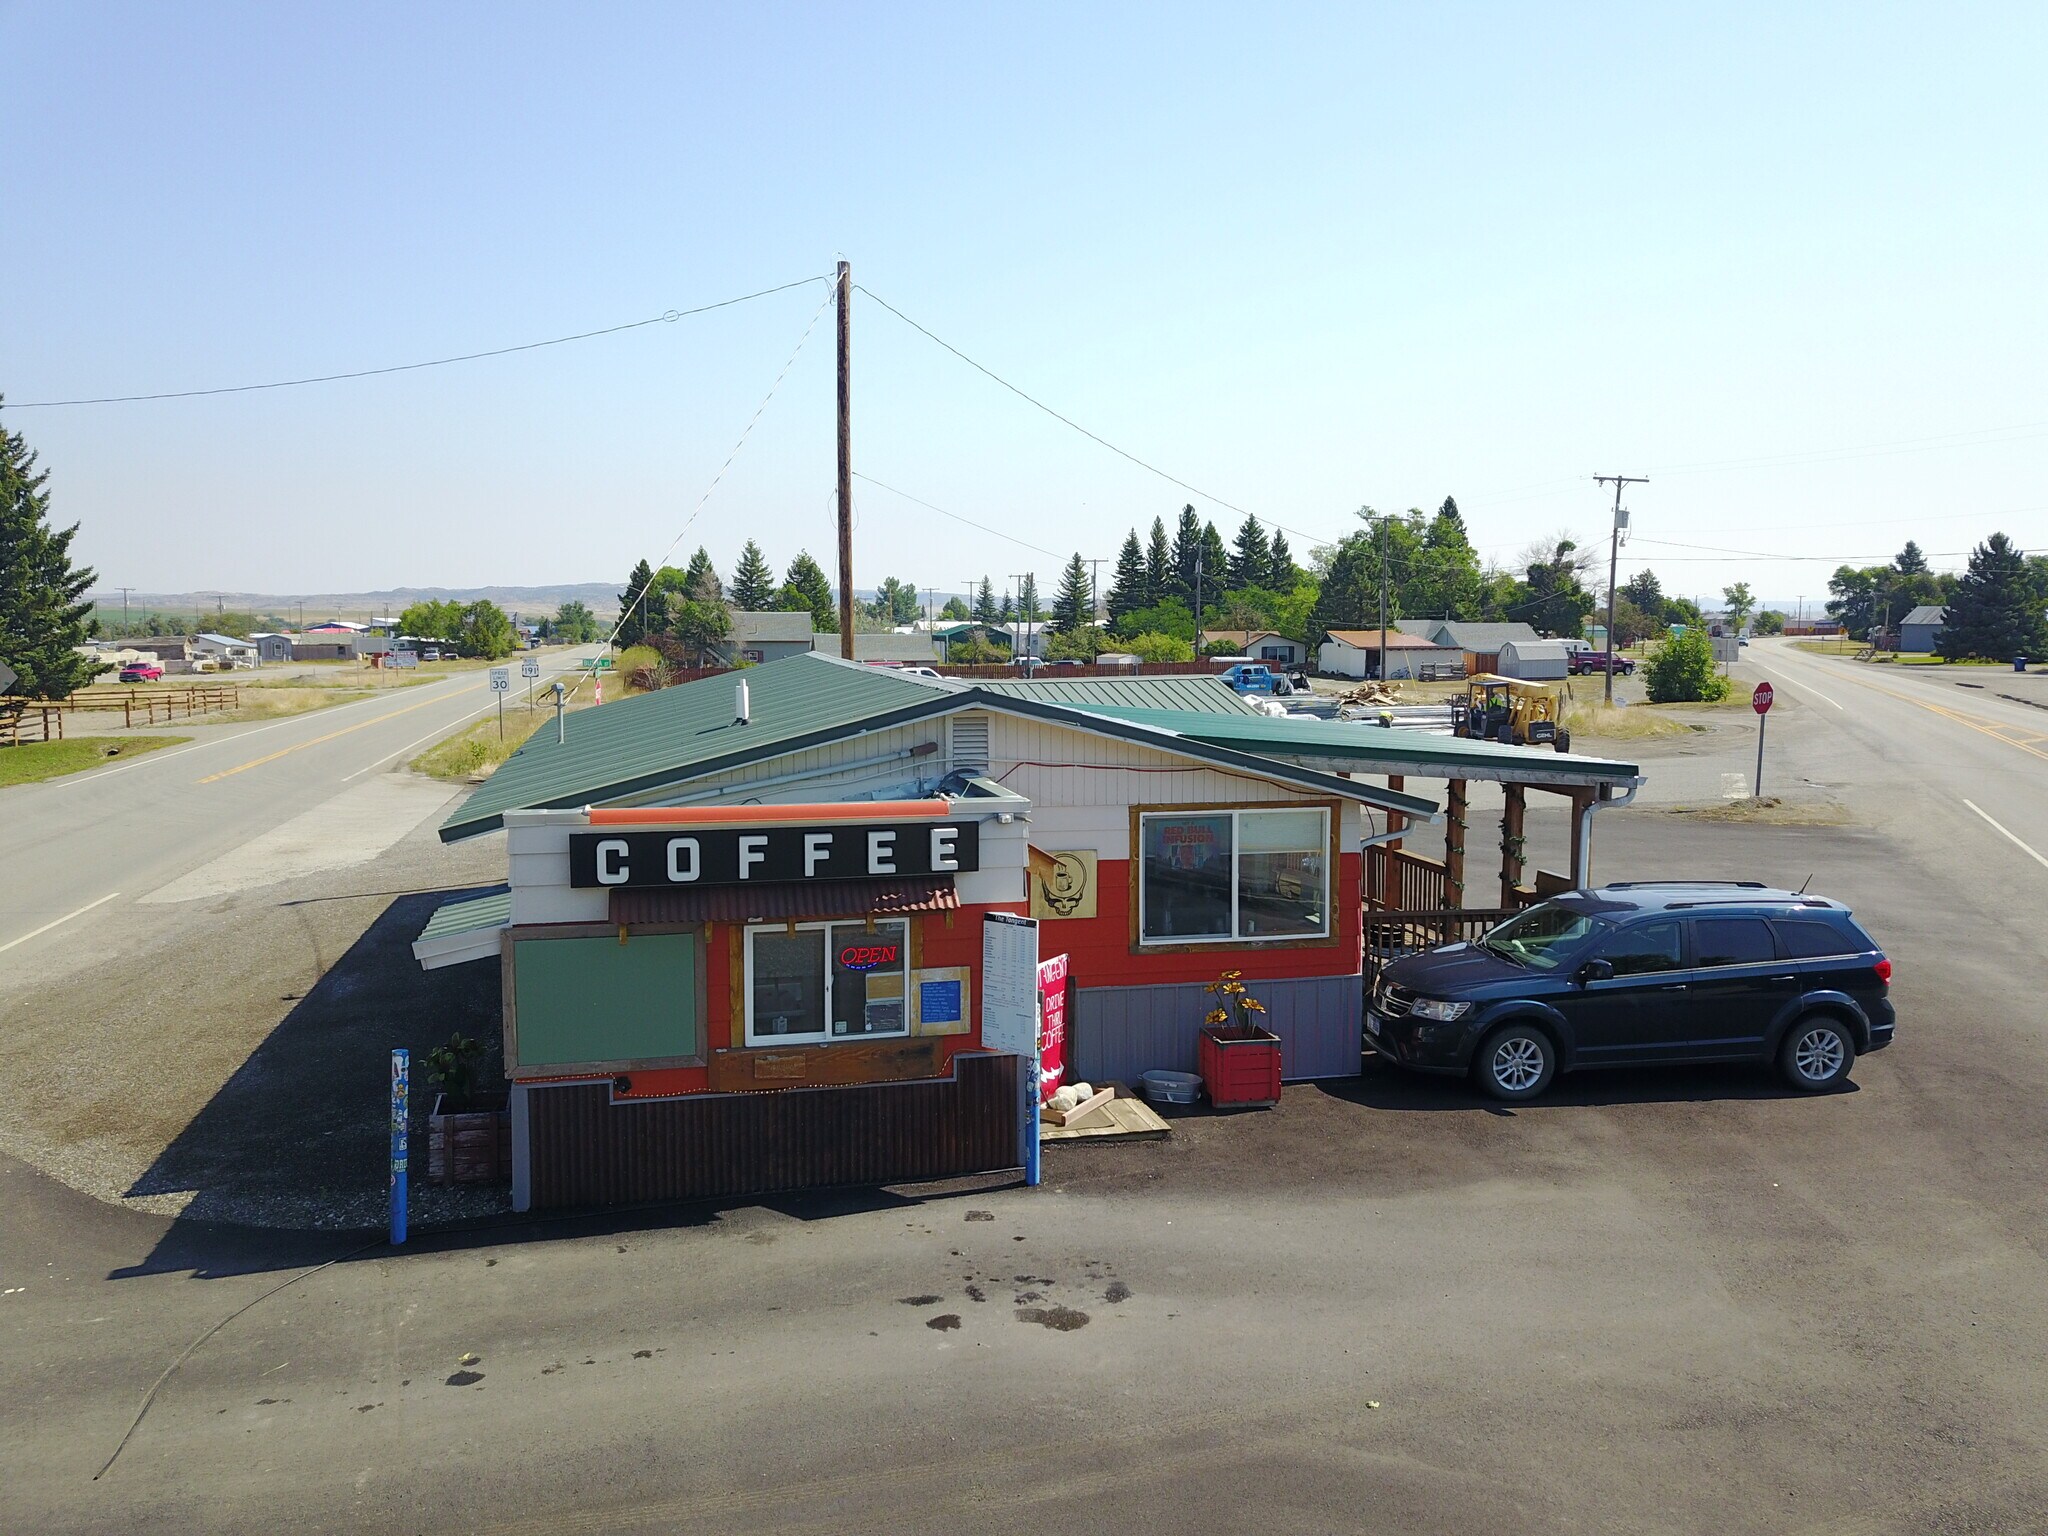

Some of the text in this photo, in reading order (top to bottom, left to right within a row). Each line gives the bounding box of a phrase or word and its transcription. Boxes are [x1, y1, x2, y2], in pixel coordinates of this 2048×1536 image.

[524, 667, 537, 675] 191
[492, 680, 508, 689] 30
[1753, 691, 1773, 705] STOP
[1164, 825, 1213, 835] RED BULL
[1163, 833, 1214, 843] INFUSION
[595, 827, 960, 885] COFFEE
[994, 914, 1005, 922] The
[840, 945, 897, 964] OPEN
[1045, 990, 1065, 1013] DRIVE
[1047, 1009, 1064, 1030] THRU
[1041, 1022, 1066, 1051] COFFEE
